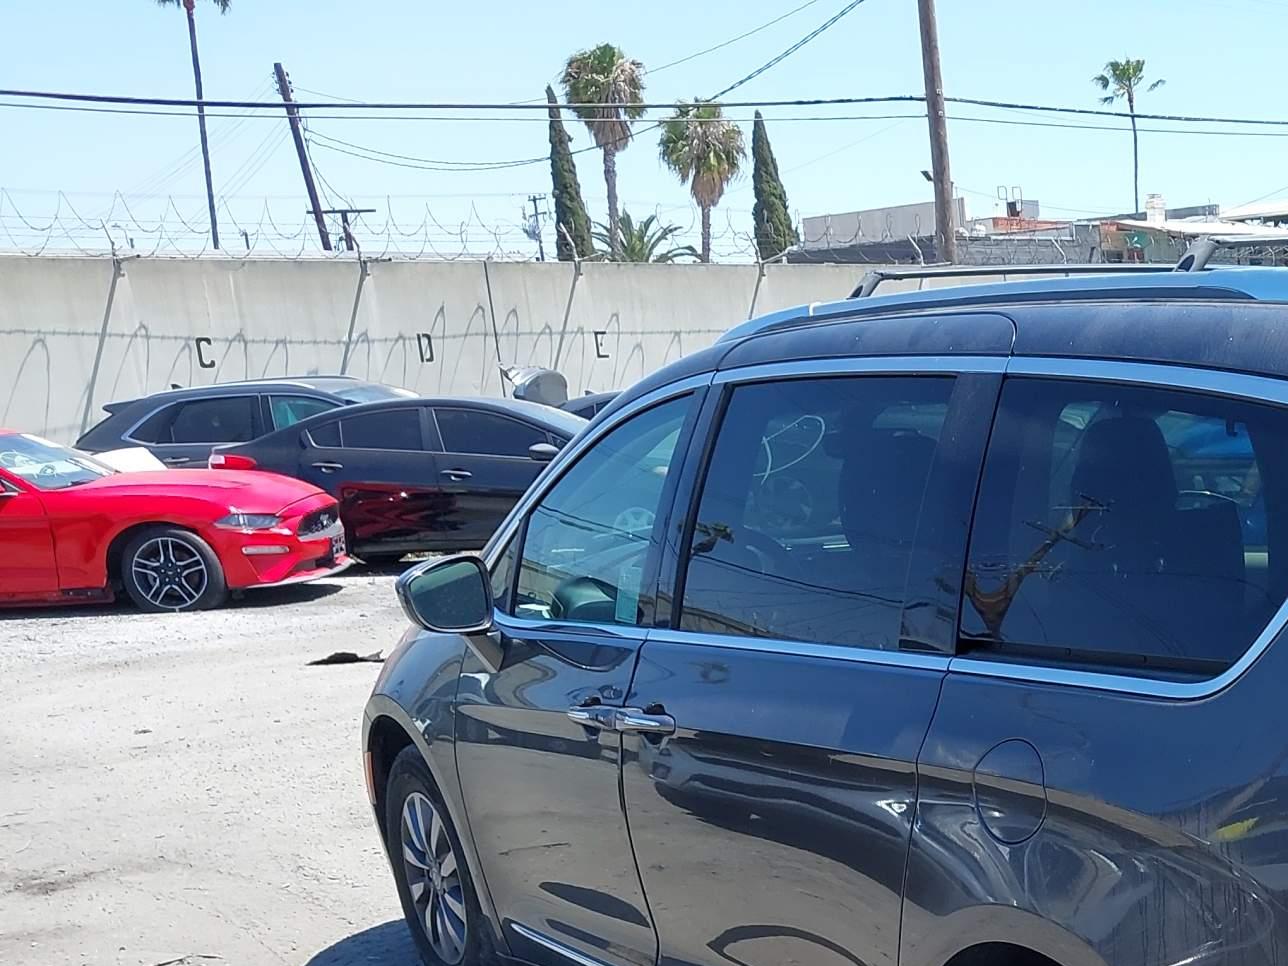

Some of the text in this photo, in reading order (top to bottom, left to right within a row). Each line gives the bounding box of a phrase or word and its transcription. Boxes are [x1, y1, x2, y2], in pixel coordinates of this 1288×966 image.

[195, 337, 216, 369] C
[416, 333, 435, 363] D
[594, 331, 610, 358] E
